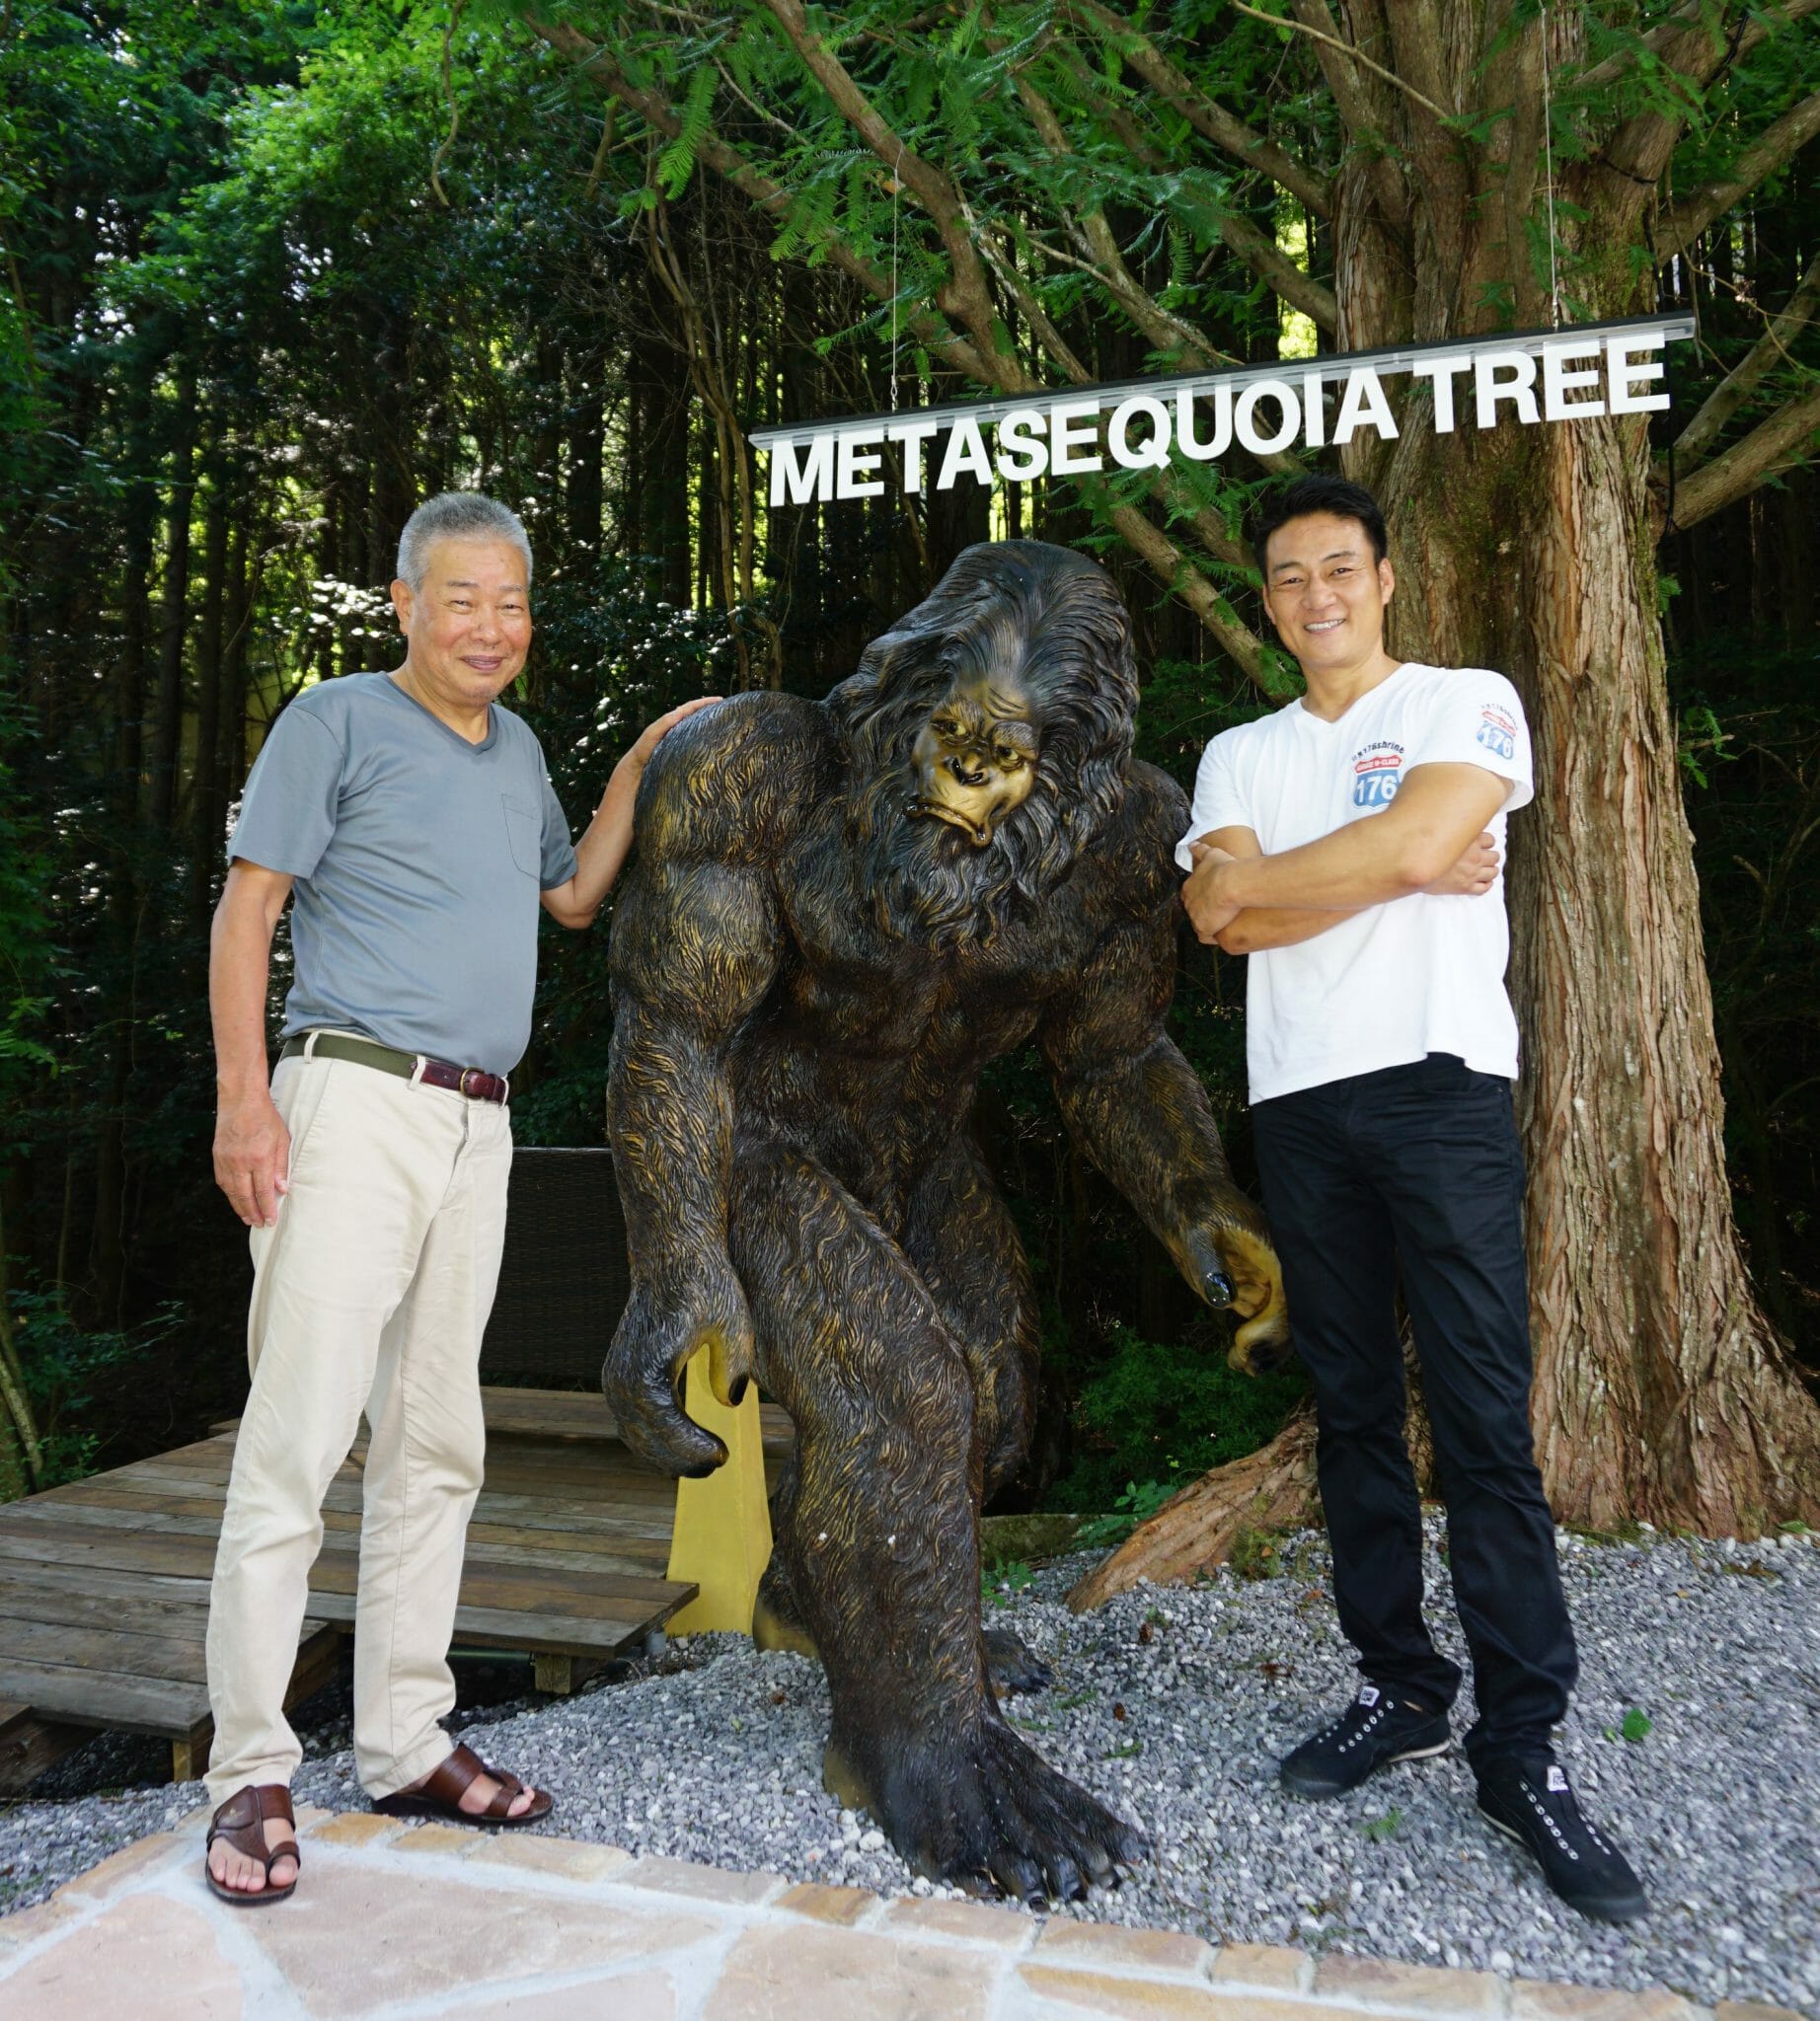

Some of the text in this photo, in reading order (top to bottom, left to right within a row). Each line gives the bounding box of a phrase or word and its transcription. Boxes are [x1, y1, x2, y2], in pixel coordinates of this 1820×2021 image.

[770, 332, 1670, 507] METASEQUOIA TREE
[1480, 724, 1513, 759] 176
[1357, 775, 1398, 803] 176
